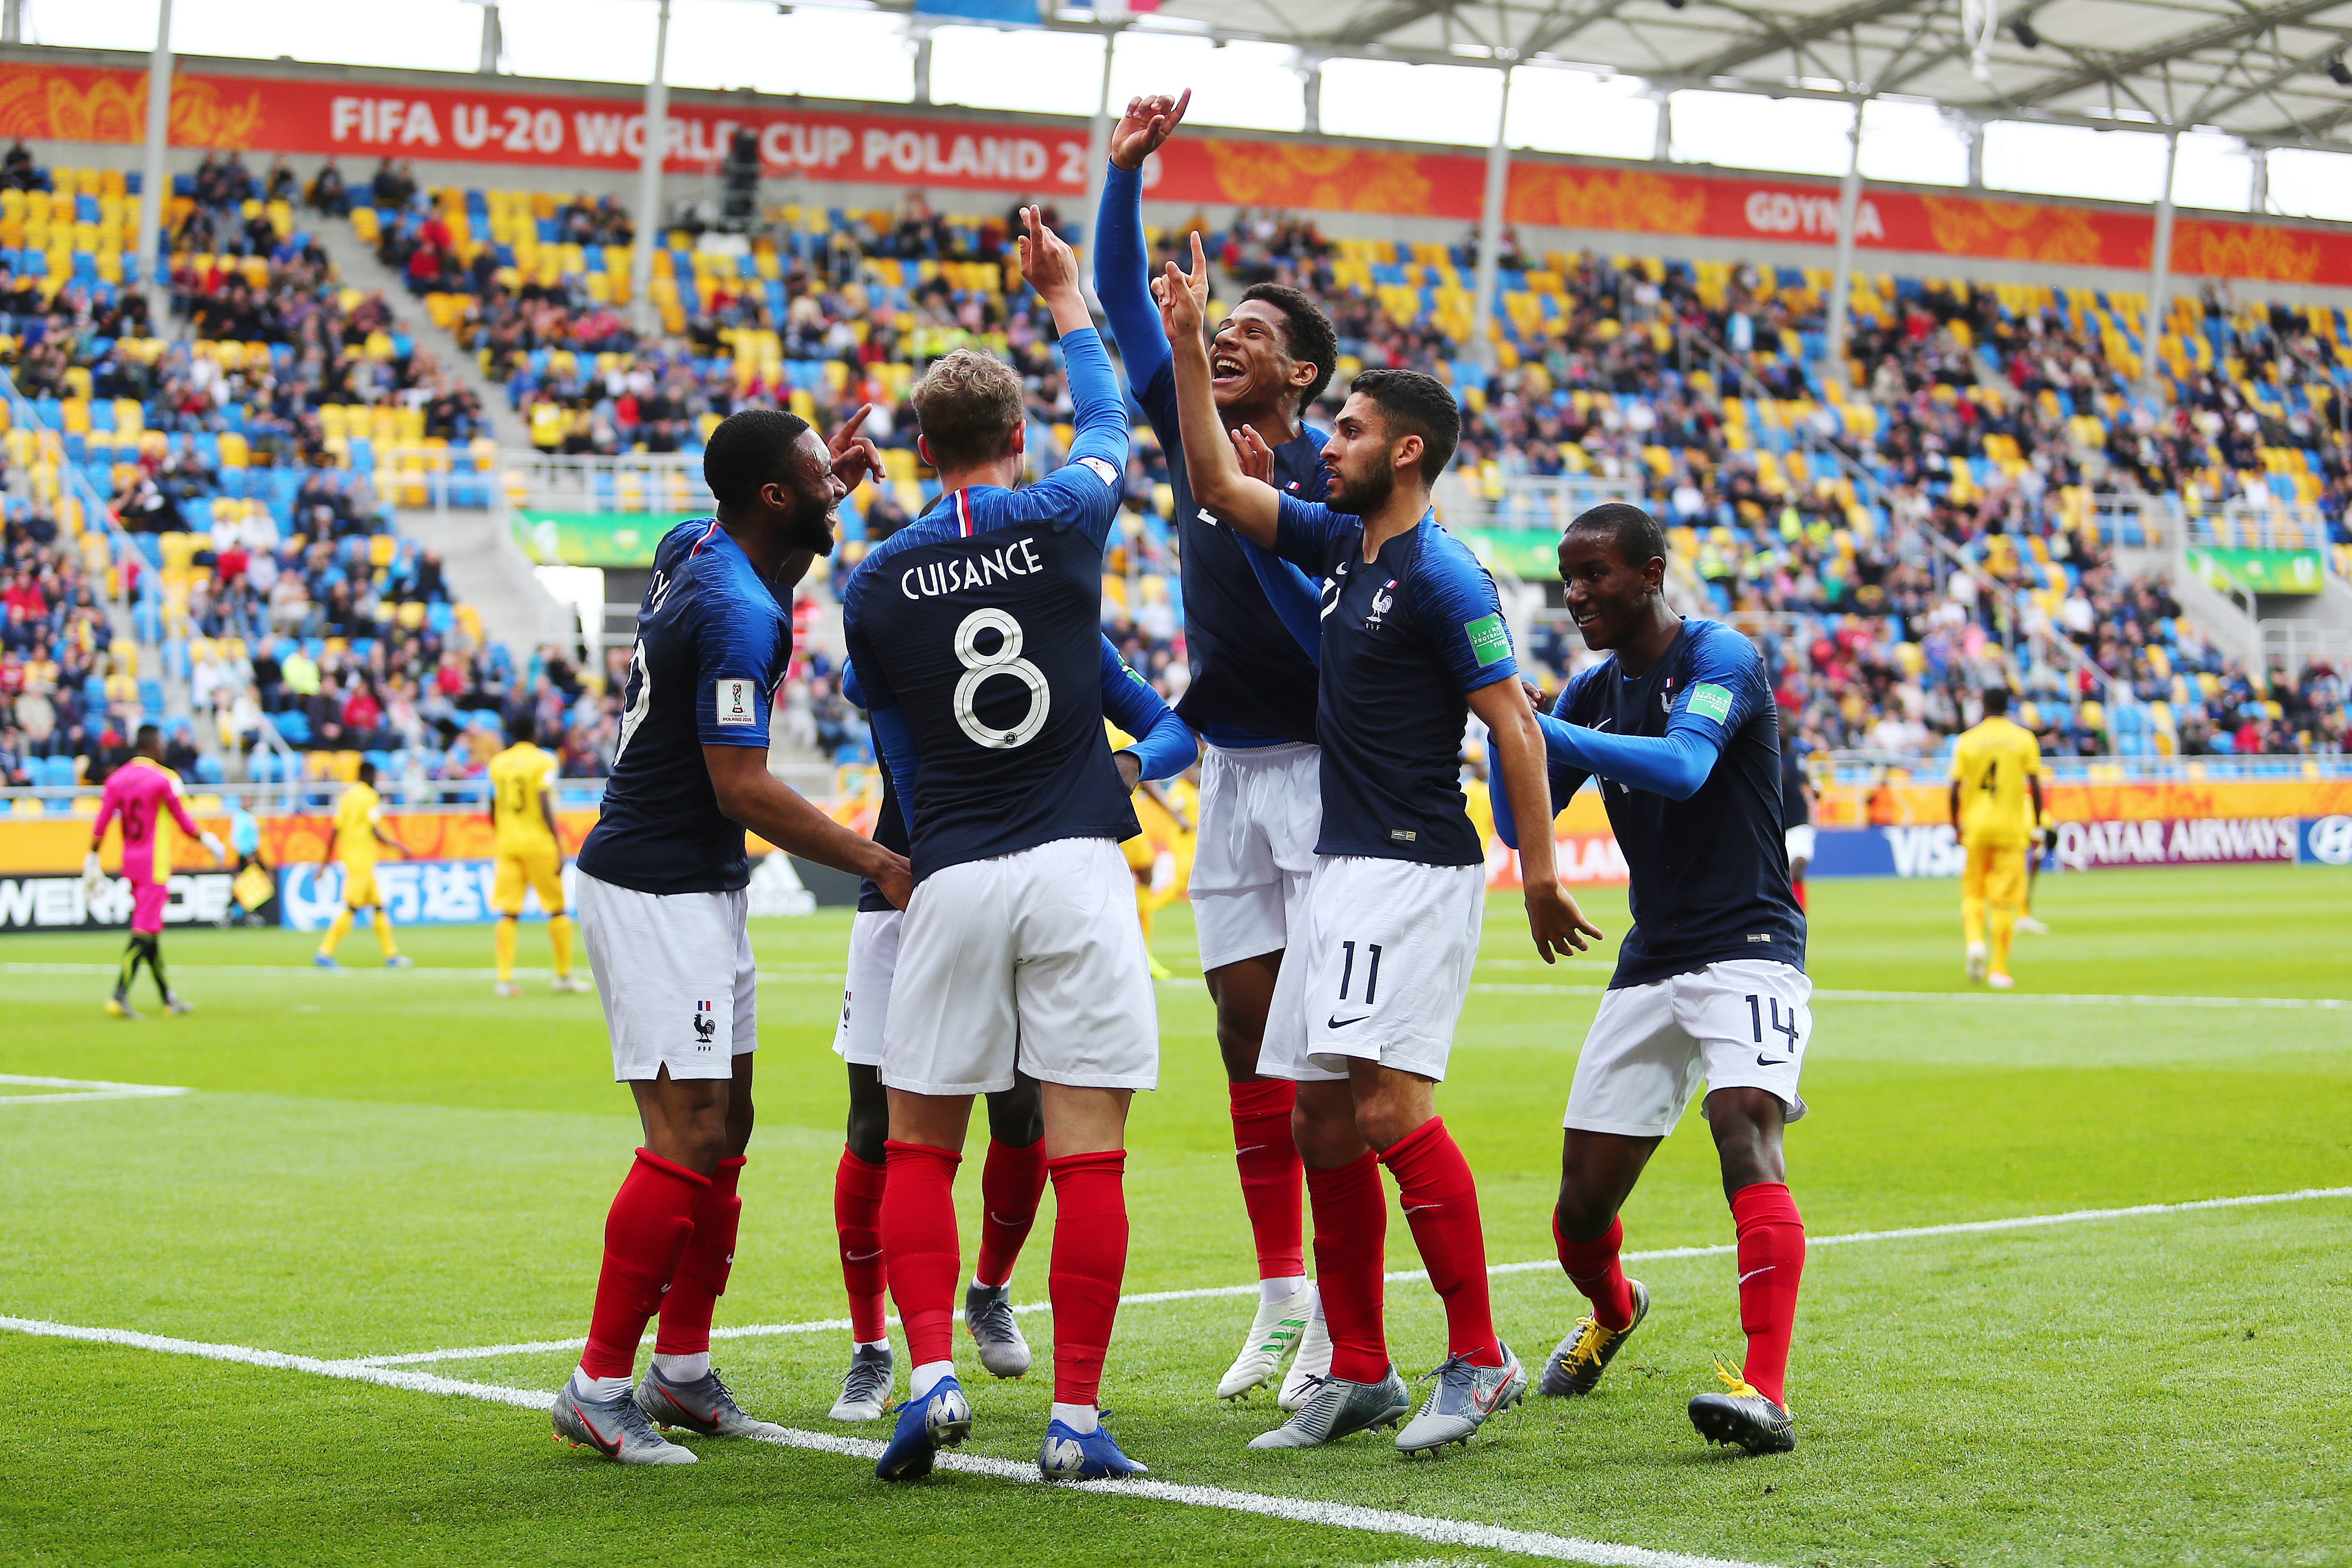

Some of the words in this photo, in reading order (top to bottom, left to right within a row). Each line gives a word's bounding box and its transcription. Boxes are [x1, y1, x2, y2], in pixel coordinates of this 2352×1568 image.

[332, 96, 441, 147] FIFA
[451, 103, 565, 154] U-20
[759, 121, 854, 169] CUP
[862, 128, 1049, 181] POLAND
[1745, 190, 1886, 240] GDYNA
[901, 537, 1043, 600] CUISANCE
[1472, 626, 1501, 639] LIVING
[1493, 639, 1506, 648] FIFA
[953, 607, 1051, 749] 8
[1710, 704, 1725, 714] FIFA
[1980, 760, 1997, 797] 4
[2058, 821, 2164, 872] QATAR
[2169, 817, 2297, 861] AIRWAYS
[1339, 940, 1382, 1004] 11
[1745, 994, 1799, 1053] 14
